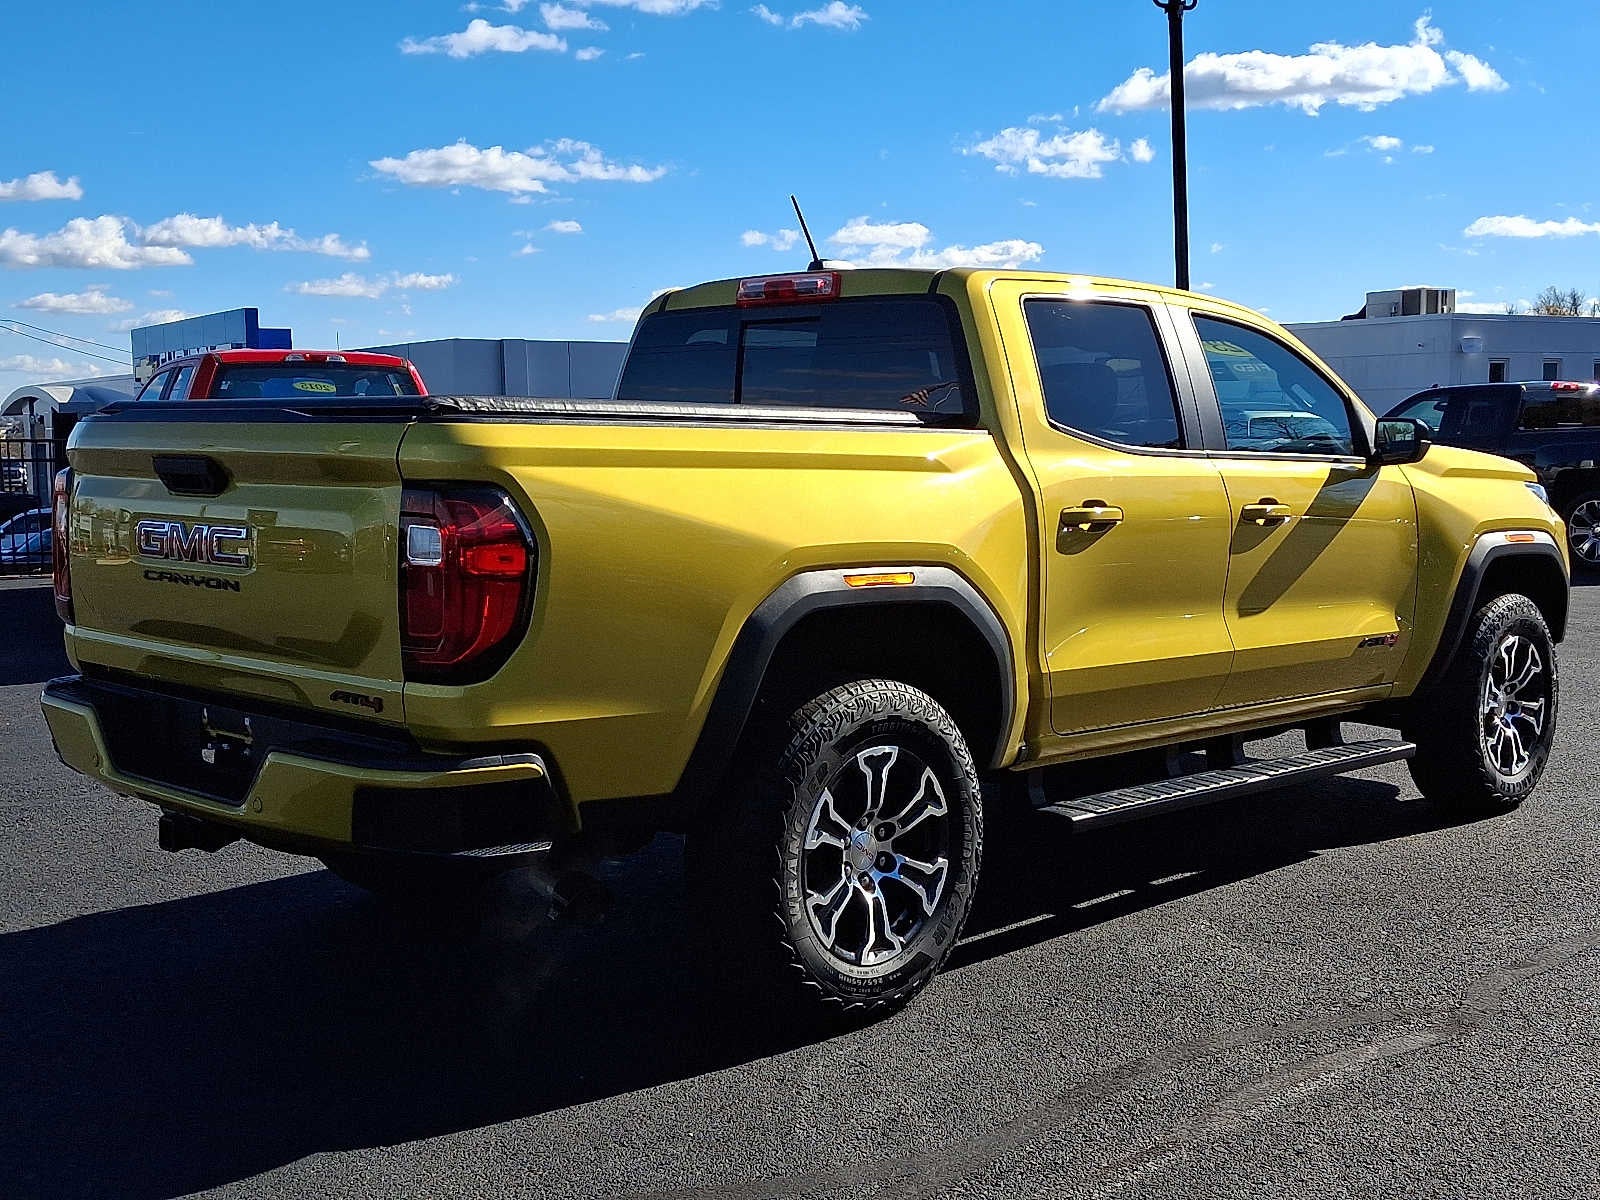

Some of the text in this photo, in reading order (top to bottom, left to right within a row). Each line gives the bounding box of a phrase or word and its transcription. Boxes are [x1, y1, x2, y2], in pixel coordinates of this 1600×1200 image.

[135, 519, 250, 569] GMC
[143, 570, 241, 592] CANYON
[329, 690, 384, 713] AT4
[855, 840, 874, 861] GMC
